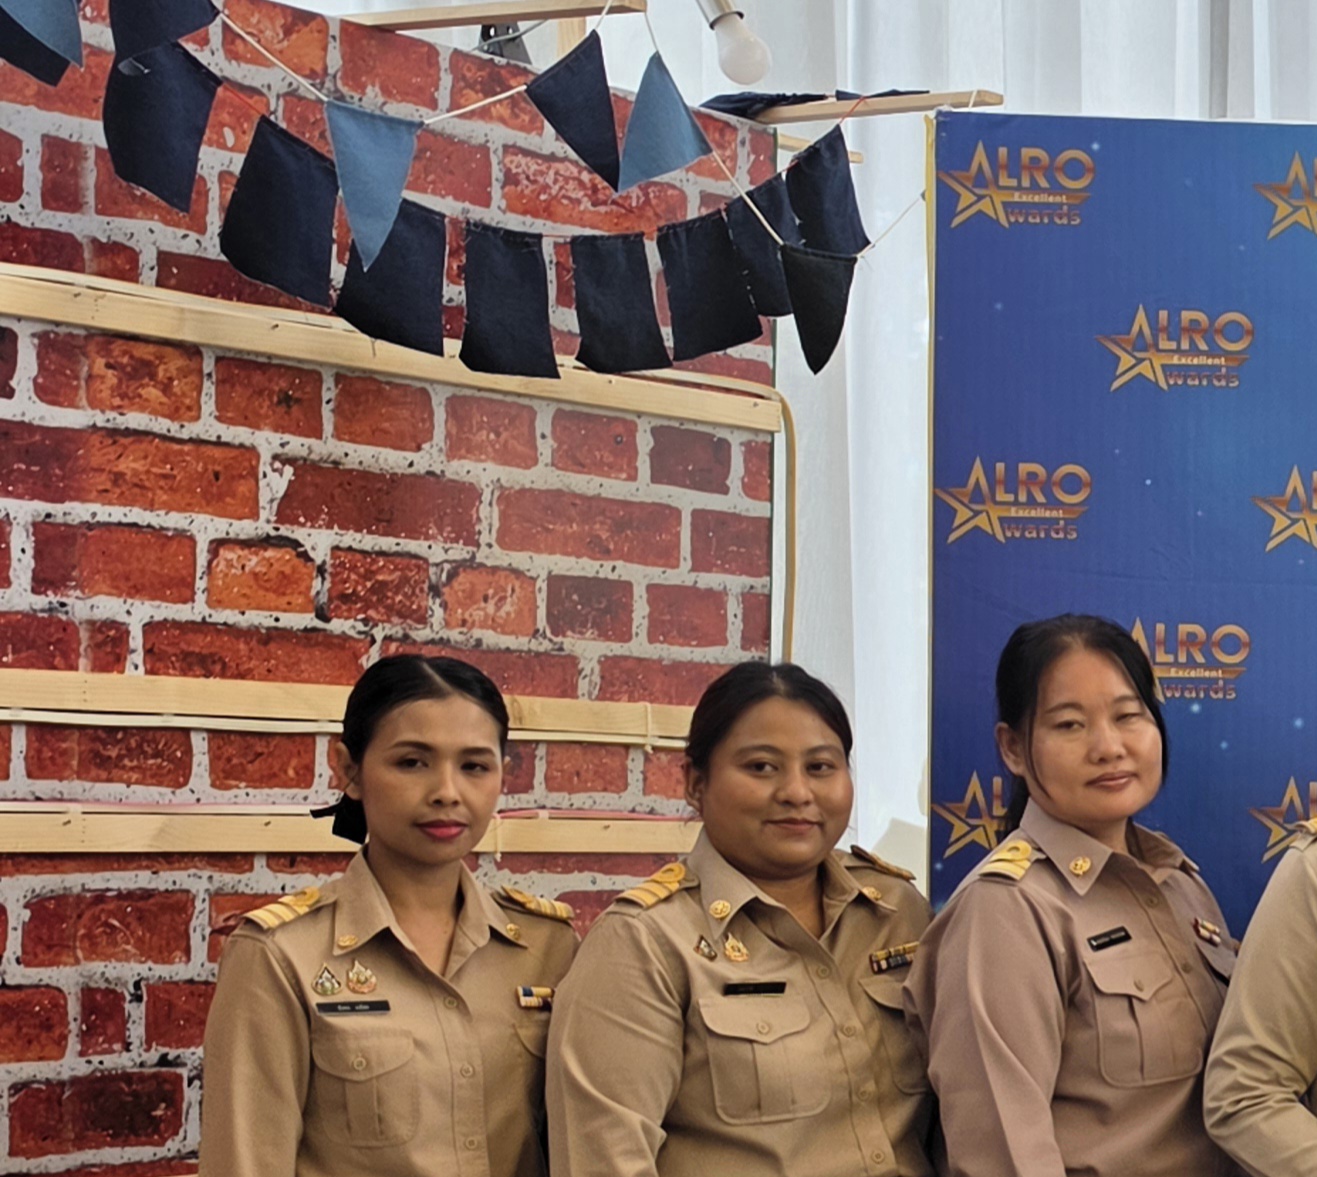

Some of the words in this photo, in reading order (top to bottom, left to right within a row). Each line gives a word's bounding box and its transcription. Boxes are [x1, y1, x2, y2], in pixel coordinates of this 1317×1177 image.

[937, 140, 1095, 196] ALRO
[1013, 192, 1068, 204] Excellent
[1094, 303, 1254, 359] ALRO
[1171, 354, 1225, 365] Excellent
[934, 455, 1091, 511] ALRO
[1010, 506, 1063, 517] Excellent
[1169, 667, 1223, 678] Excellent
